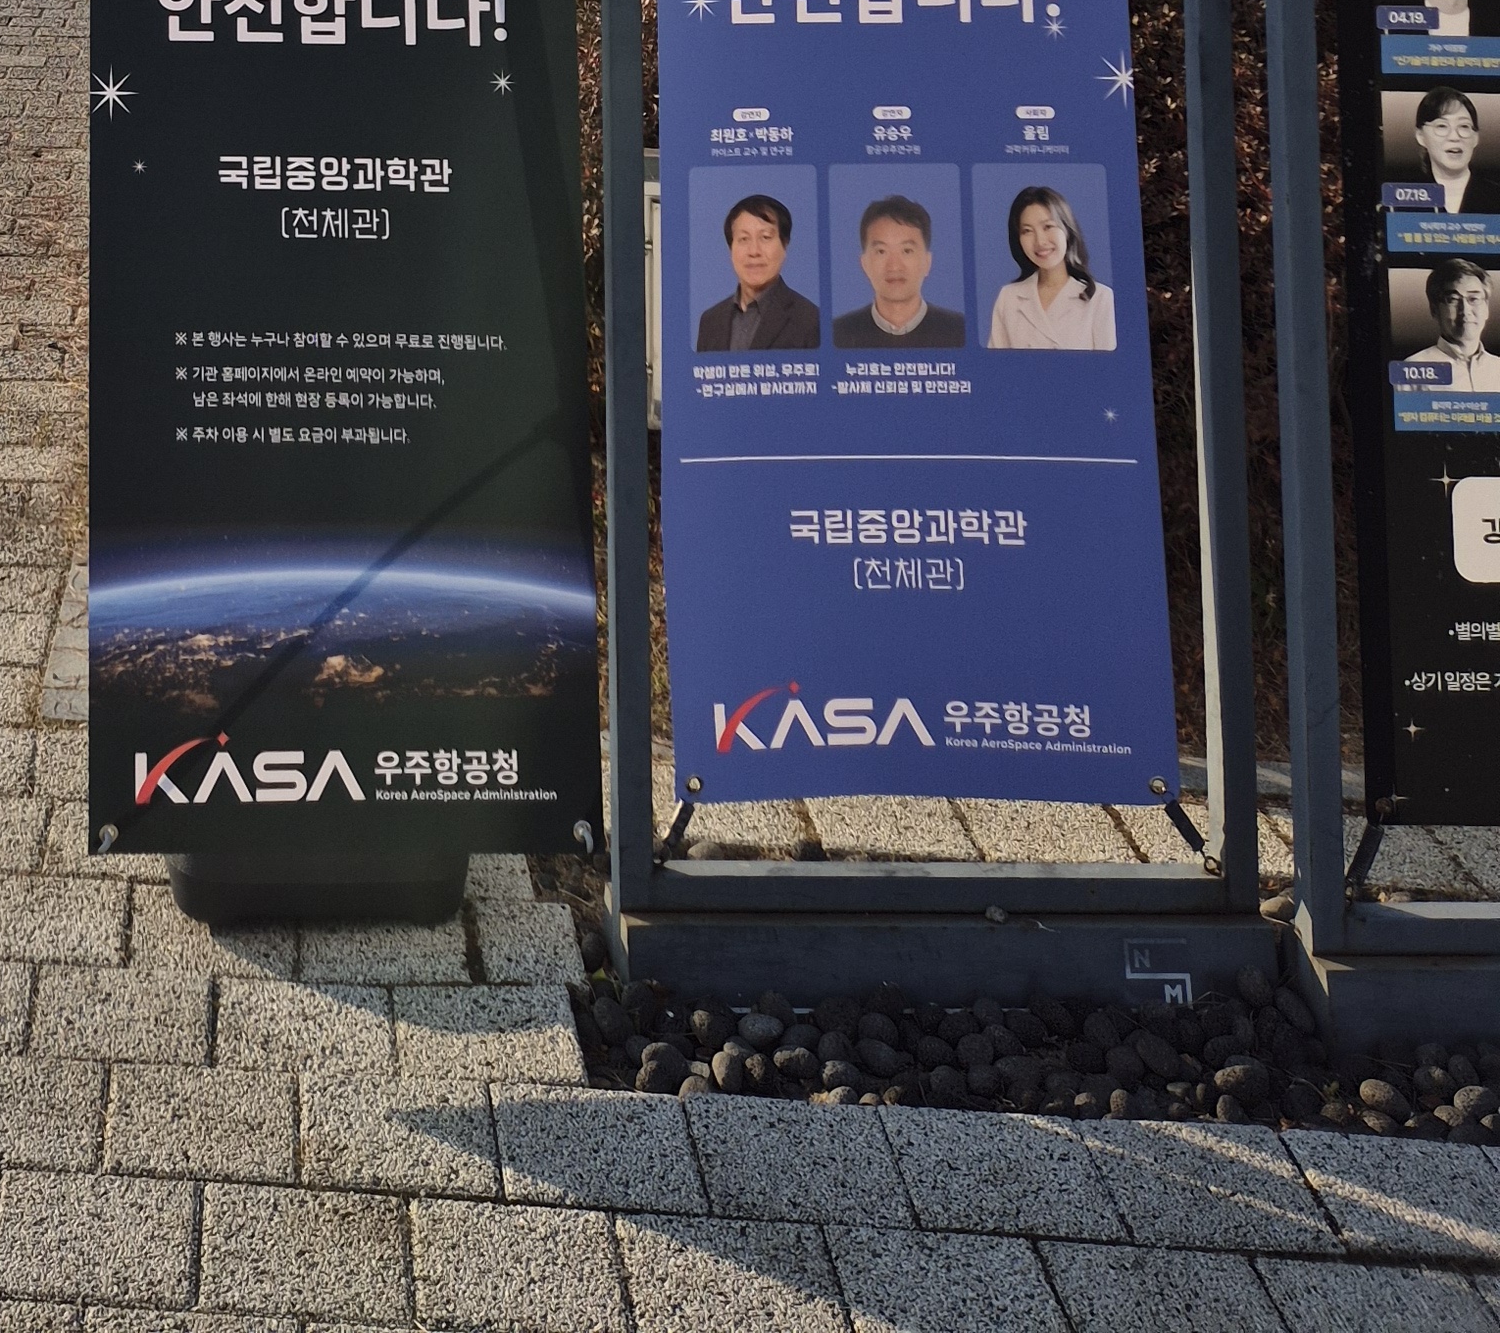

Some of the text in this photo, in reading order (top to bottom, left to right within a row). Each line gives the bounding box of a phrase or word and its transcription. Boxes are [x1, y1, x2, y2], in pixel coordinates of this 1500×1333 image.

[710, 128, 748, 143] 최원호
[755, 127, 794, 142] 박동하
[219, 156, 452, 192] 국립중앙과학관
[192, 332, 204, 346] 본
[208, 331, 247, 346] 행사는
[251, 332, 289, 346] 누구나
[293, 333, 332, 348] 참여할
[336, 333, 348, 347] 수
[353, 333, 390, 348] 있으며
[395, 334, 434, 348] 무료로
[438, 334, 506, 350] 진행됩니다.
[193, 366, 218, 381] 기관
[222, 367, 299, 381] 홈페이지에서
[304, 367, 341, 382] 온라인
[346, 368, 384, 383] 예약이
[390, 368, 444, 385] 가능하며,
[846, 363, 955, 375] 누리호는 안전합니다!
[1404, 367, 1438, 379] 10.18.
[193, 392, 436, 409] 남은 좌석에 한해 현장 등록이 가능합니다.
[193, 427, 218, 442] 주차
[223, 427, 248, 442] 이용
[253, 427, 264, 442] 시
[269, 428, 294, 443] 별도
[299, 427, 336, 443] 요금이
[341, 428, 409, 443] 부과됩니다.
[790, 509, 1027, 545] 국립중앙과학관
[1445, 672, 1491, 691] 일정은
[713, 681, 936, 754] KASA
[944, 701, 1090, 737] 우주항공청
[946, 737, 1132, 754] Korea AeroSpace Administration
[133, 728, 365, 806] KASA
[375, 750, 518, 785] 우주항공청
[376, 789, 557, 802] Korea AeroSpace Administration
